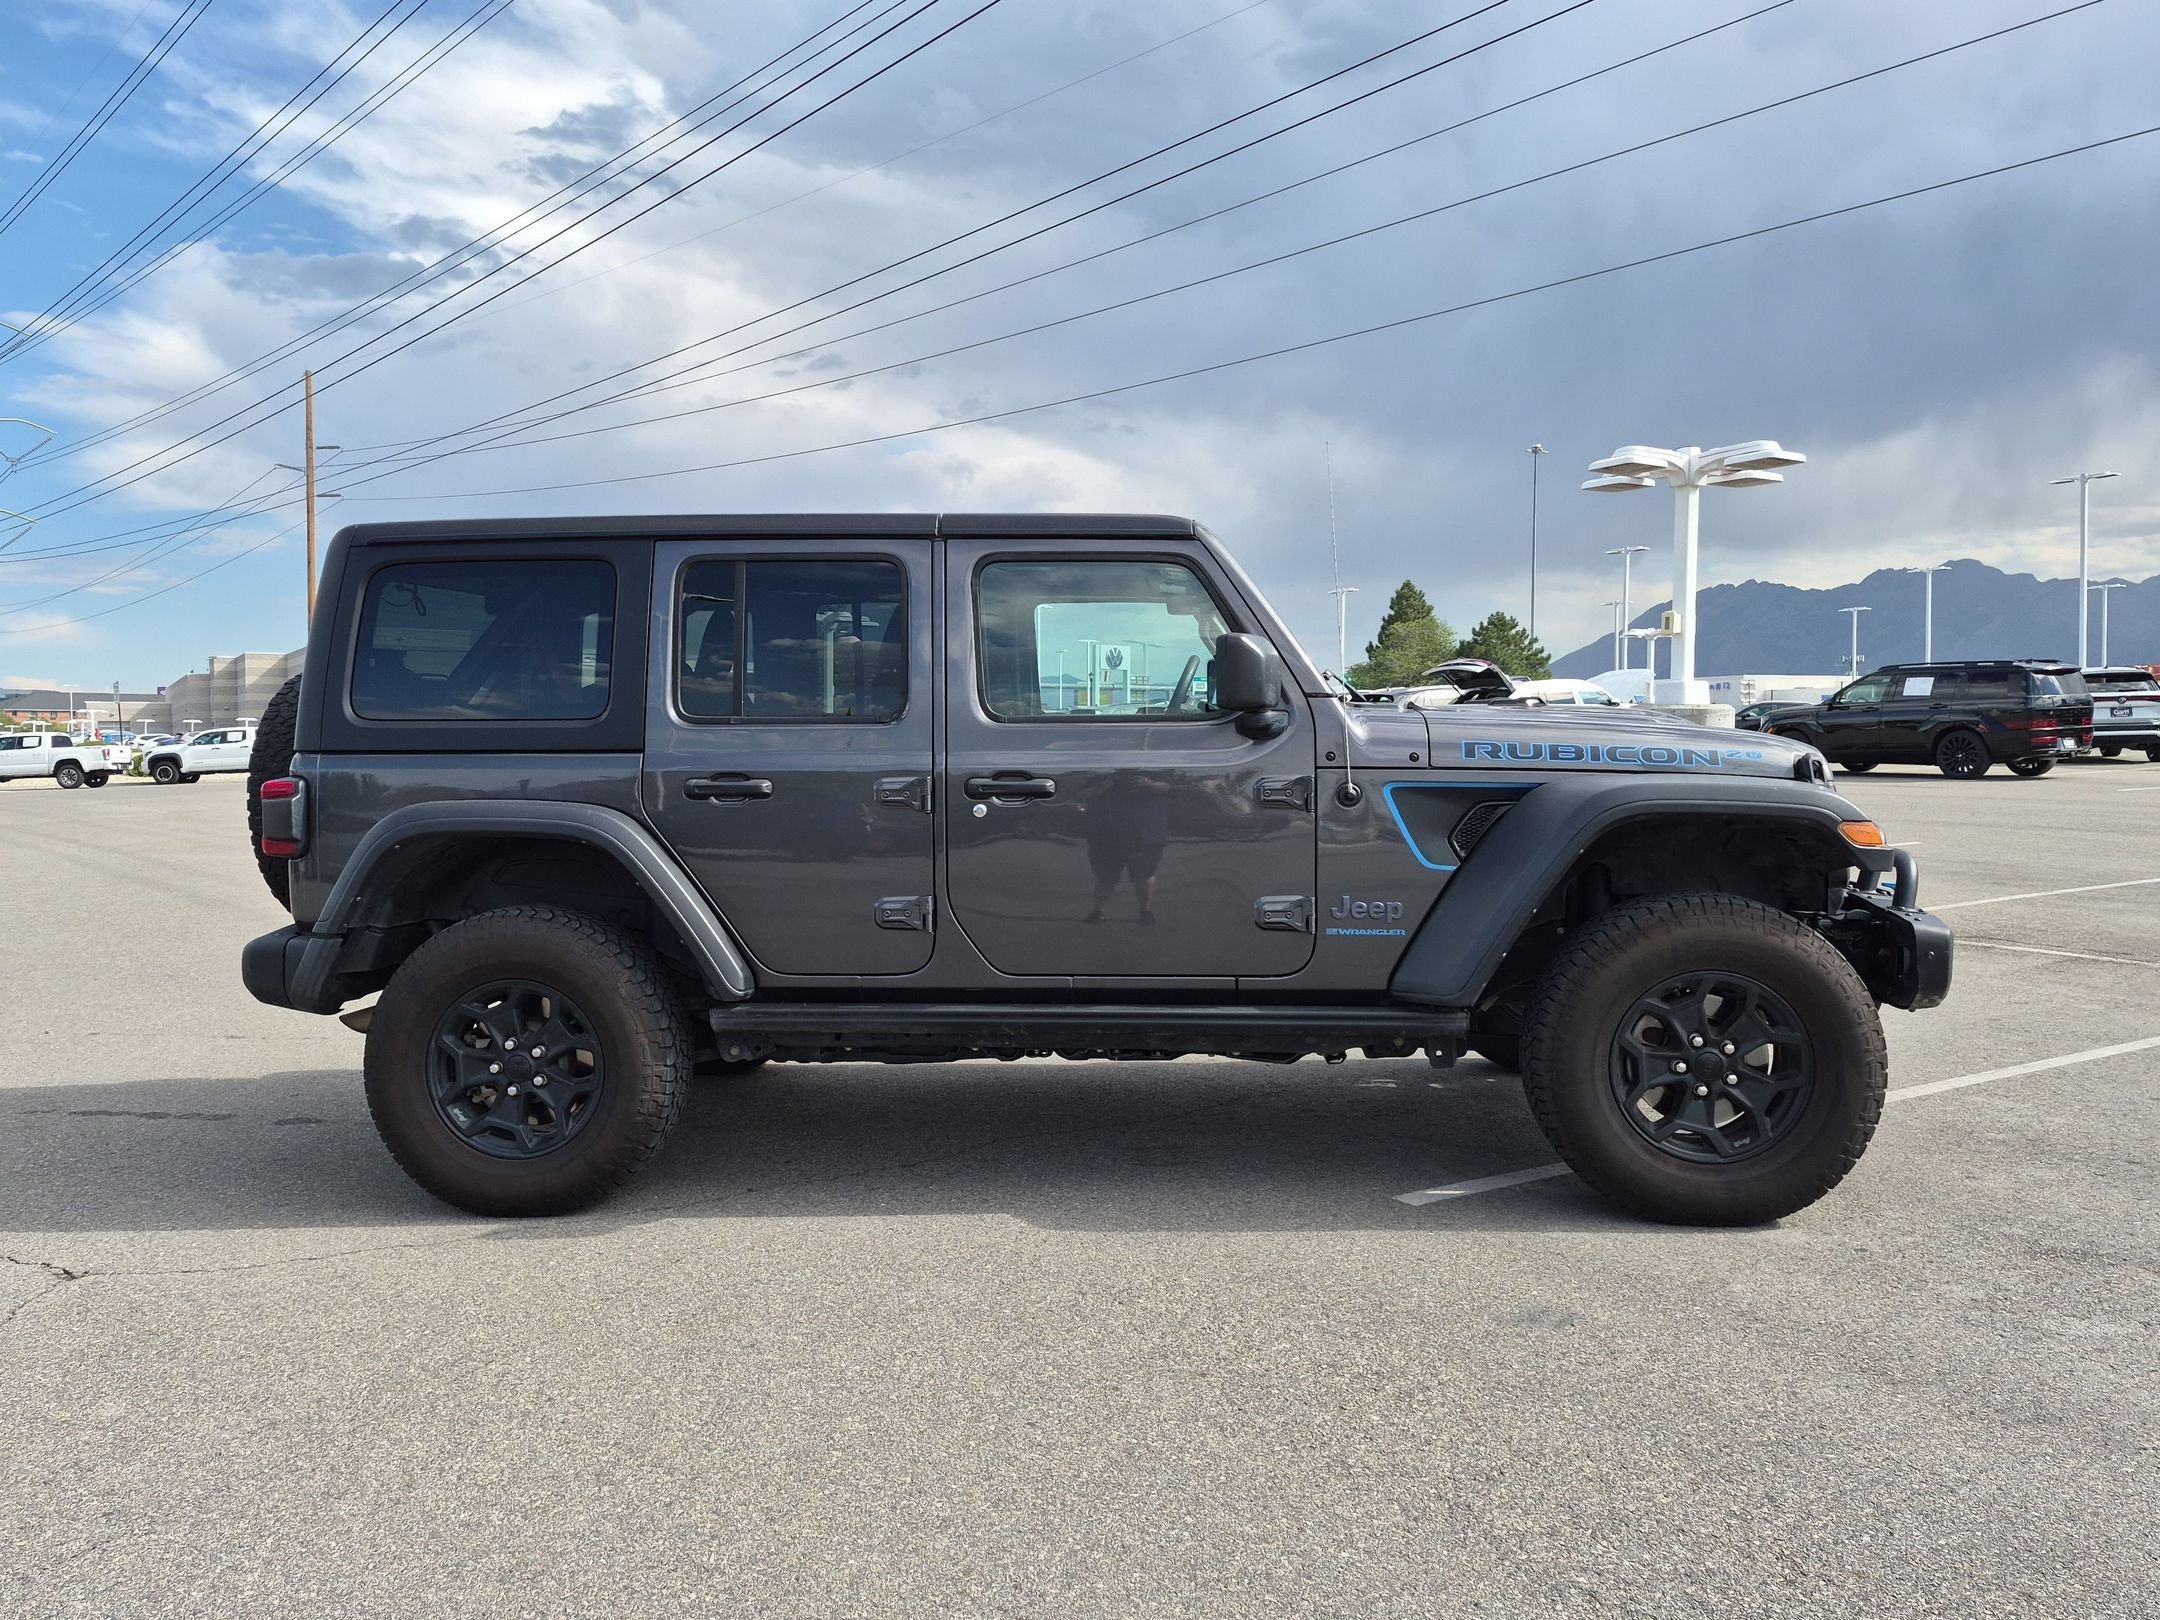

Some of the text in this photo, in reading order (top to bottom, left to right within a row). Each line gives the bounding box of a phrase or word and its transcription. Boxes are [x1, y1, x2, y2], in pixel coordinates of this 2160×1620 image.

[1461, 740, 1722, 768] RUBICON
[1330, 895, 1404, 924] Jeep
[1337, 928, 1408, 936] WRANGLER
